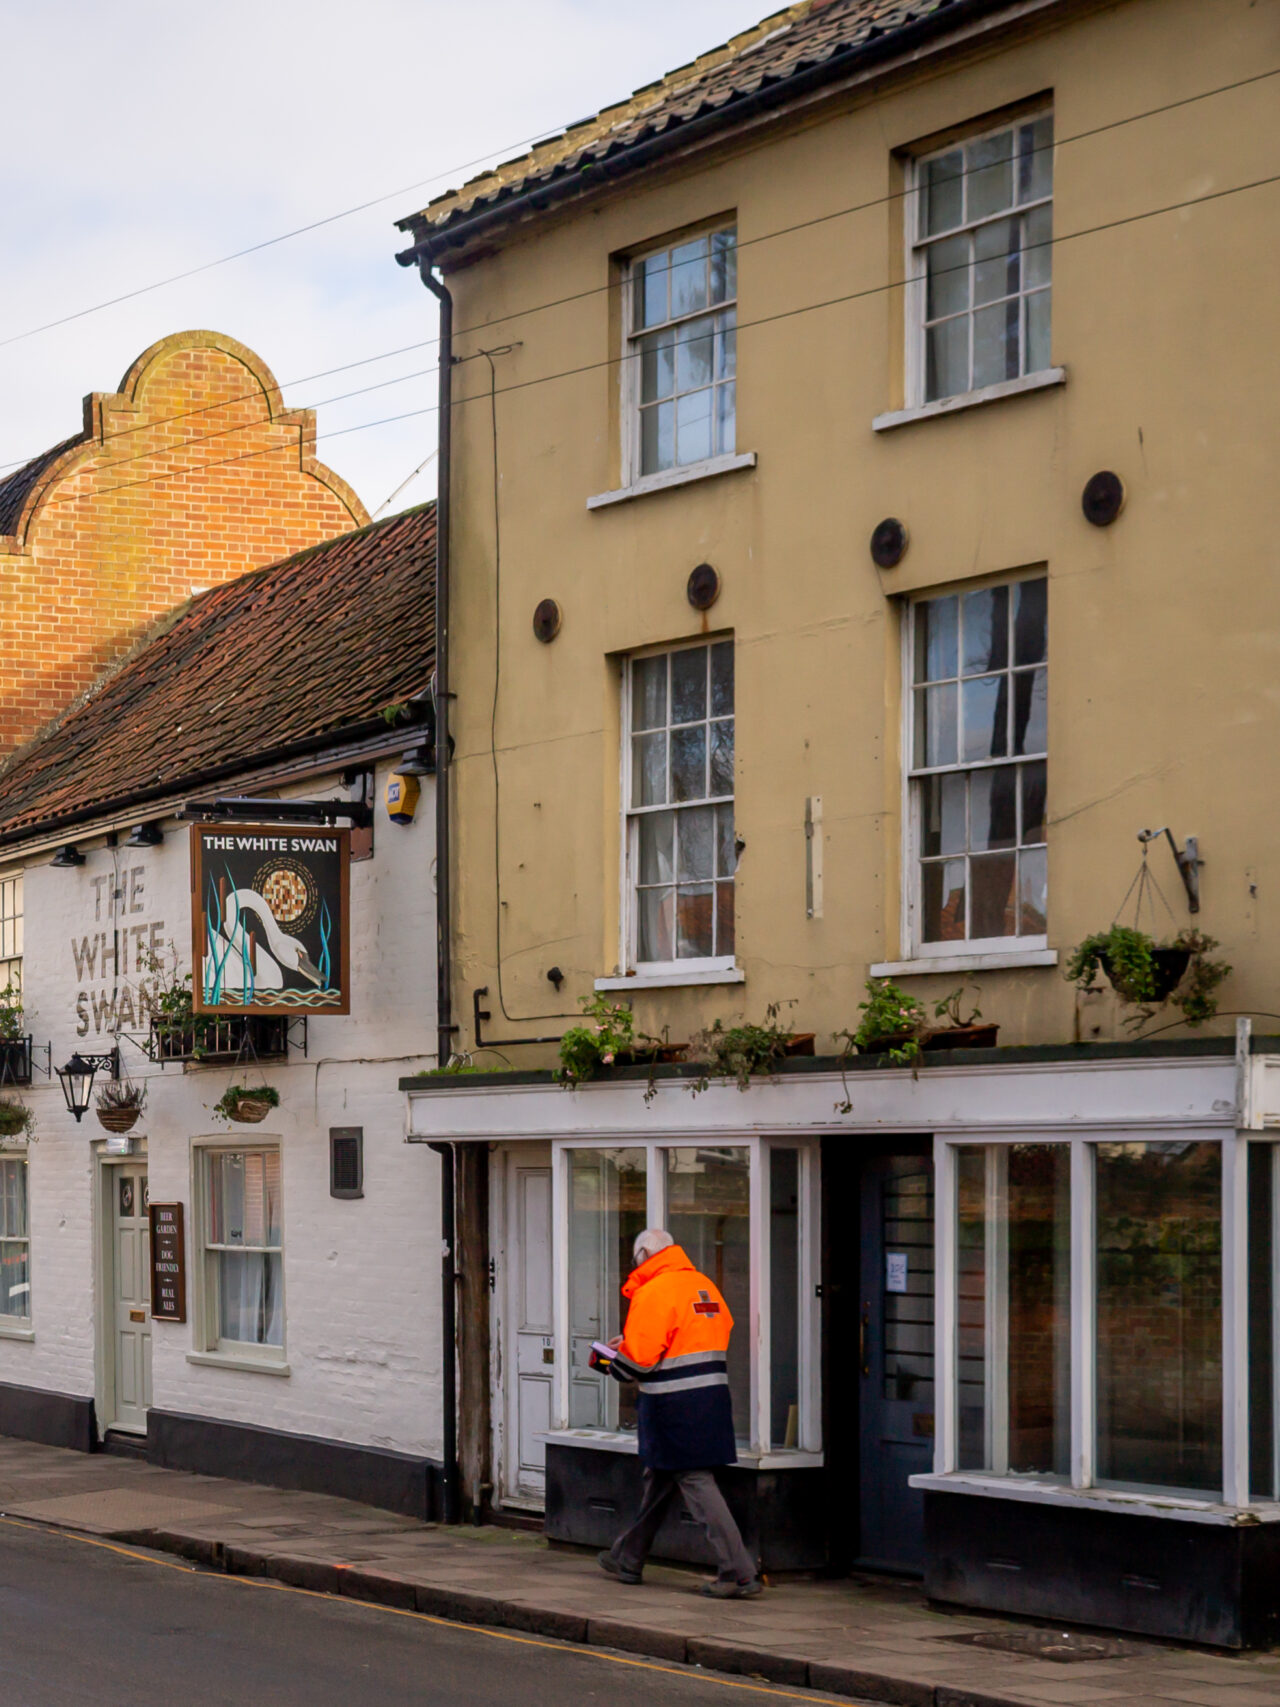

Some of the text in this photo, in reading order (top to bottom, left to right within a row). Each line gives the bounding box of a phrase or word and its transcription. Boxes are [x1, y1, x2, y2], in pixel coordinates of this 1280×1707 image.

[203, 837, 337, 852] THE WHITE SWAN
[90, 865, 145, 922] THE
[71, 920, 165, 983] WHITE
[76, 981, 160, 1038] SWAN
[160, 1212, 173, 1221] BEER
[156, 1224, 177, 1234] GARDEN
[161, 1250, 173, 1260] DOG
[155, 1263, 179, 1272] FRIENDLY
[162, 1288, 175, 1298] REAL
[163, 1301, 175, 1311] ALES
